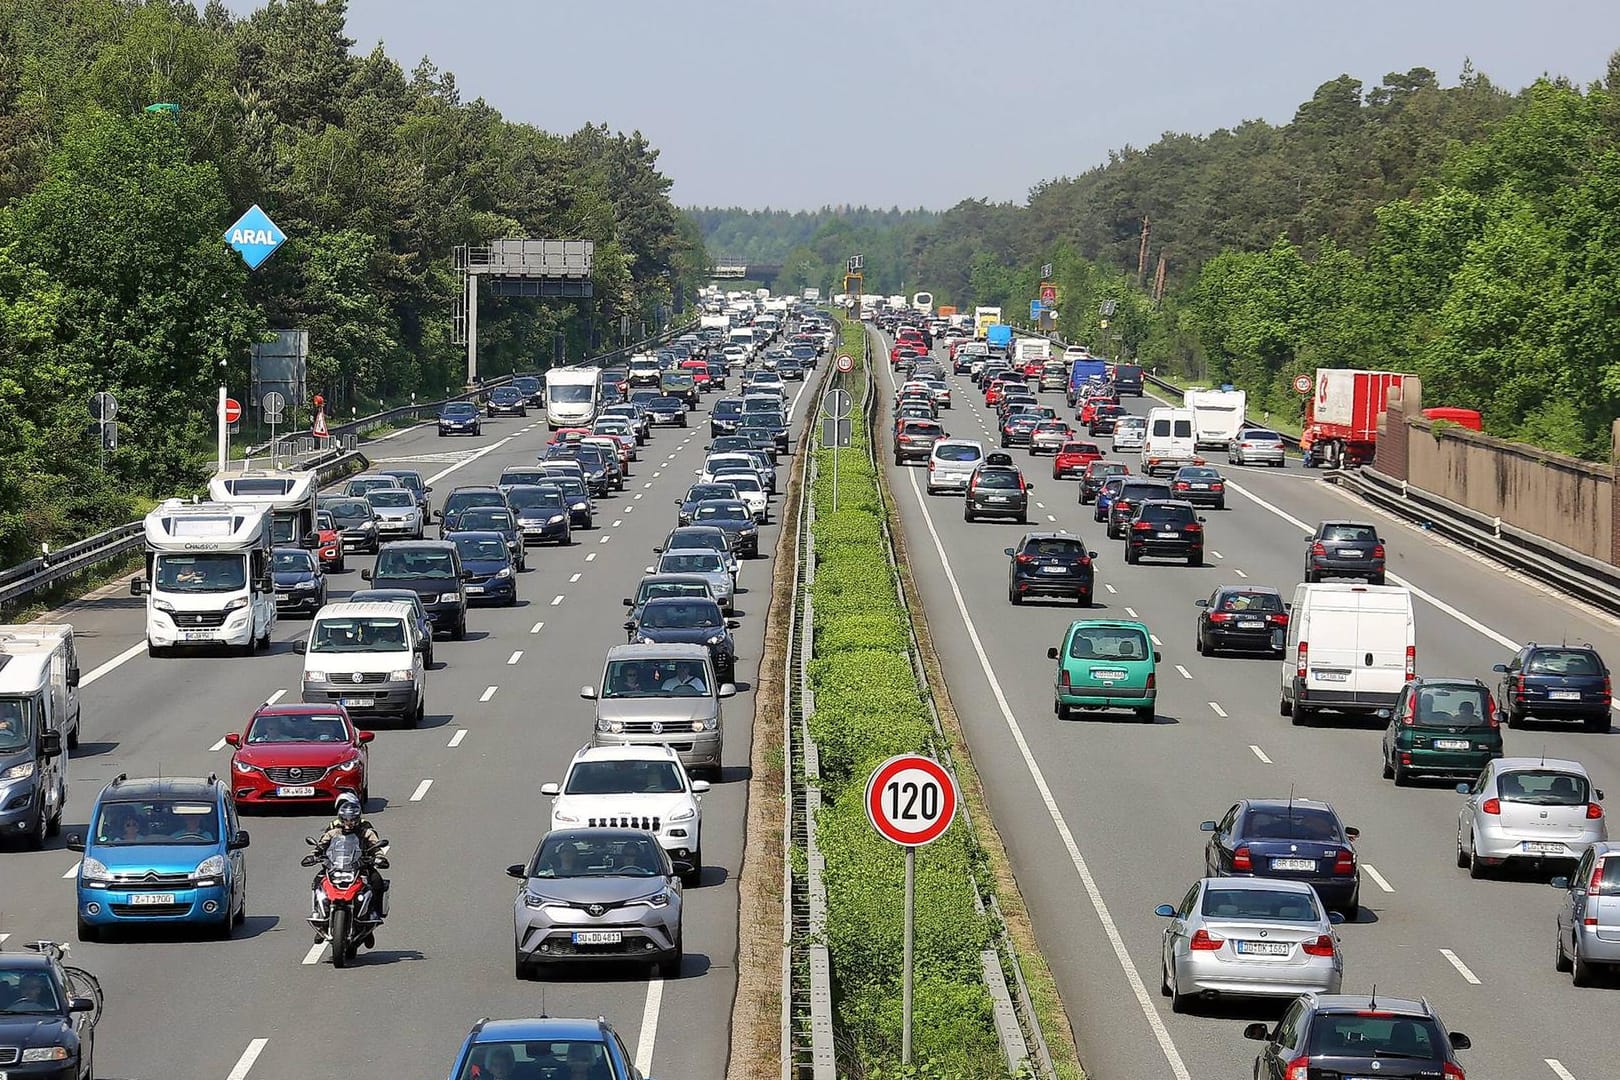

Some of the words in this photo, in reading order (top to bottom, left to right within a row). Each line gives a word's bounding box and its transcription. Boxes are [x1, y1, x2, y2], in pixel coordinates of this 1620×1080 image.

[231, 229, 277, 245] ARAL
[887, 782, 938, 820] 120
[578, 933, 587, 942] SU
